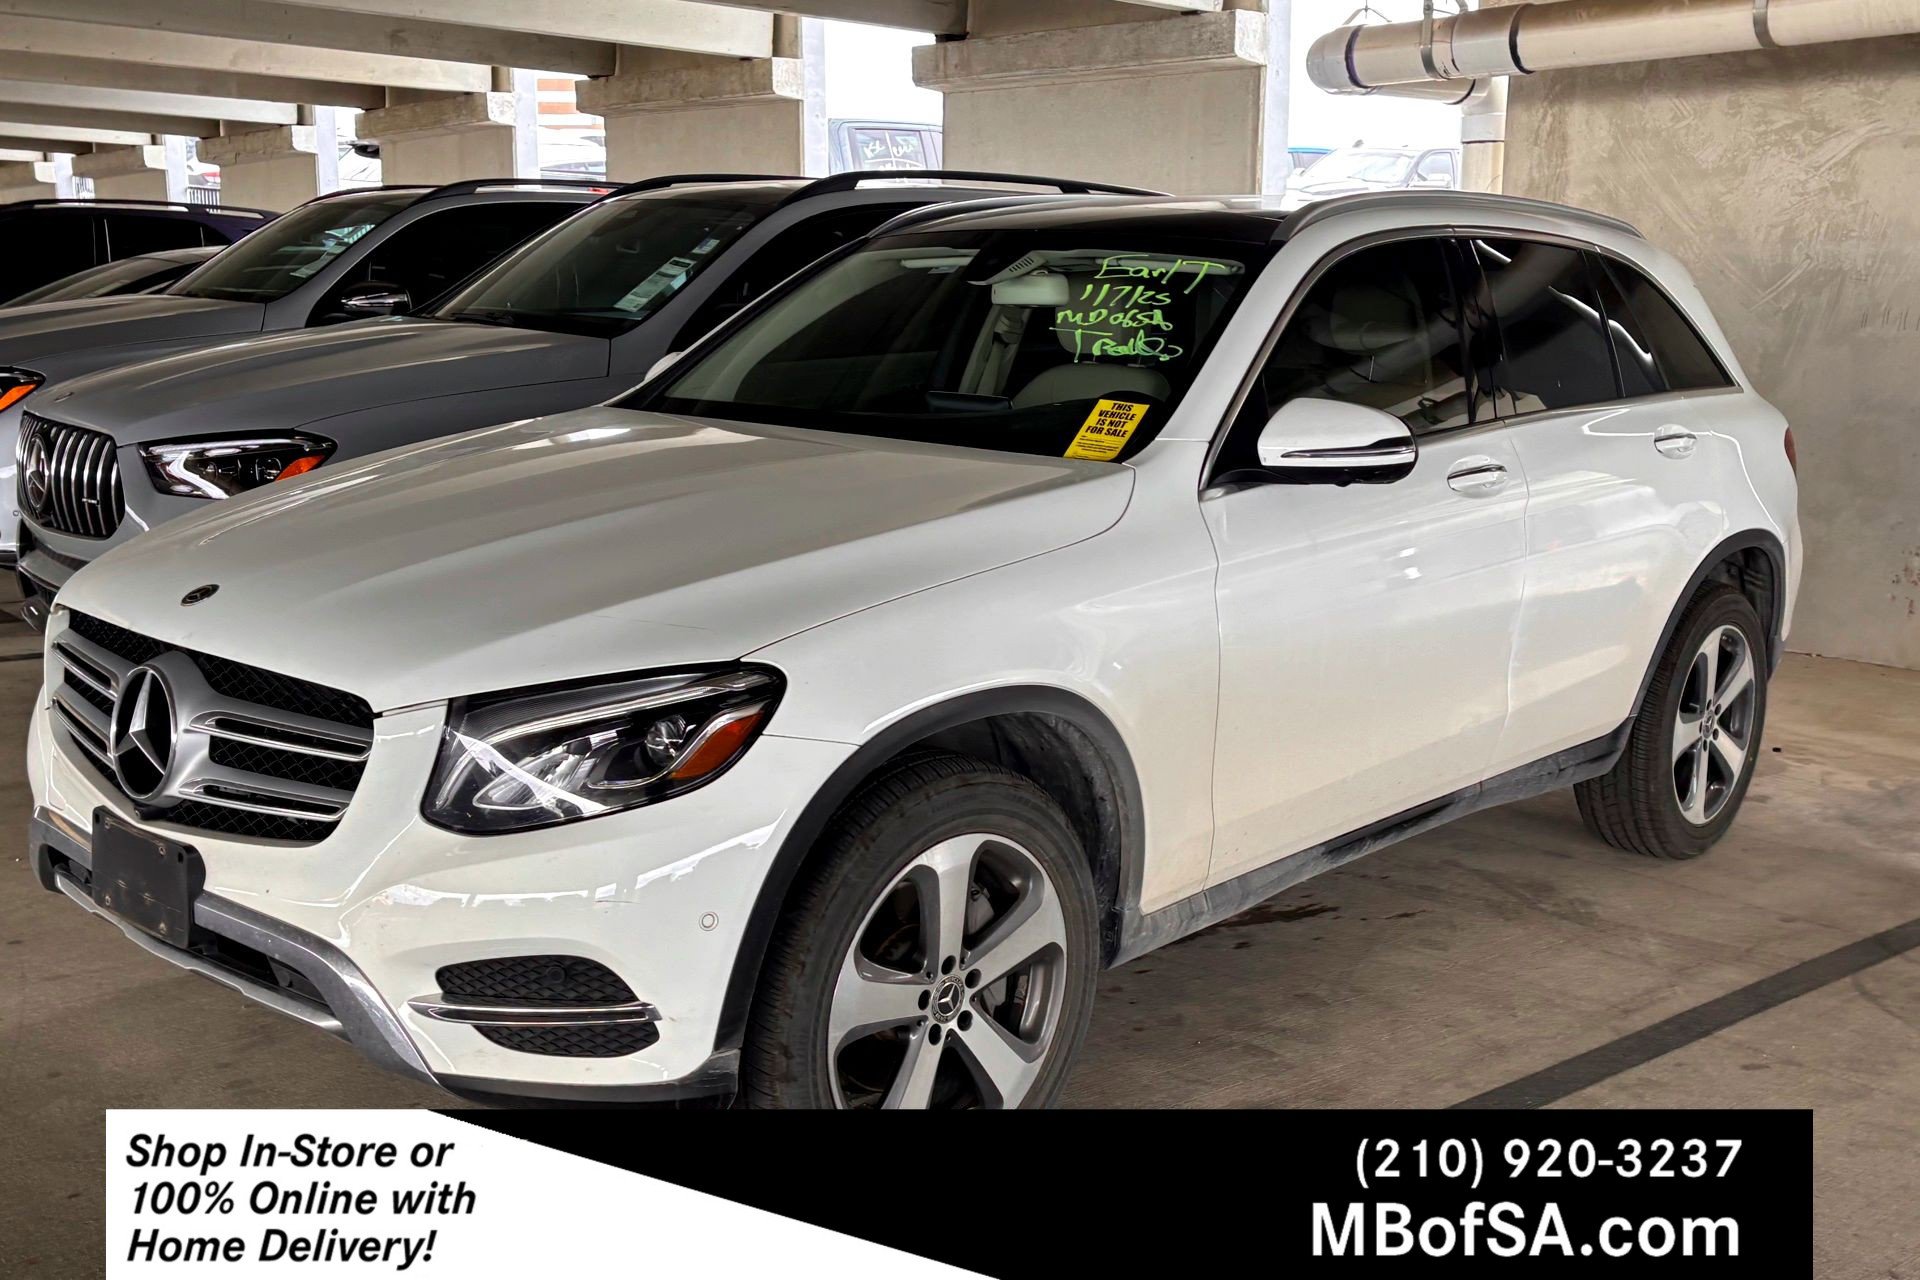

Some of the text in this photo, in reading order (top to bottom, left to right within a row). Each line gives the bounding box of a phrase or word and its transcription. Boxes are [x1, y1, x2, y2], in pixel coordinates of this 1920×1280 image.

[1111, 402, 1134, 412] THIS
[1098, 409, 1136, 421] VEHICLE
[1096, 417, 1128, 428] IS NOT
[1085, 425, 1128, 438] FOR SALE
